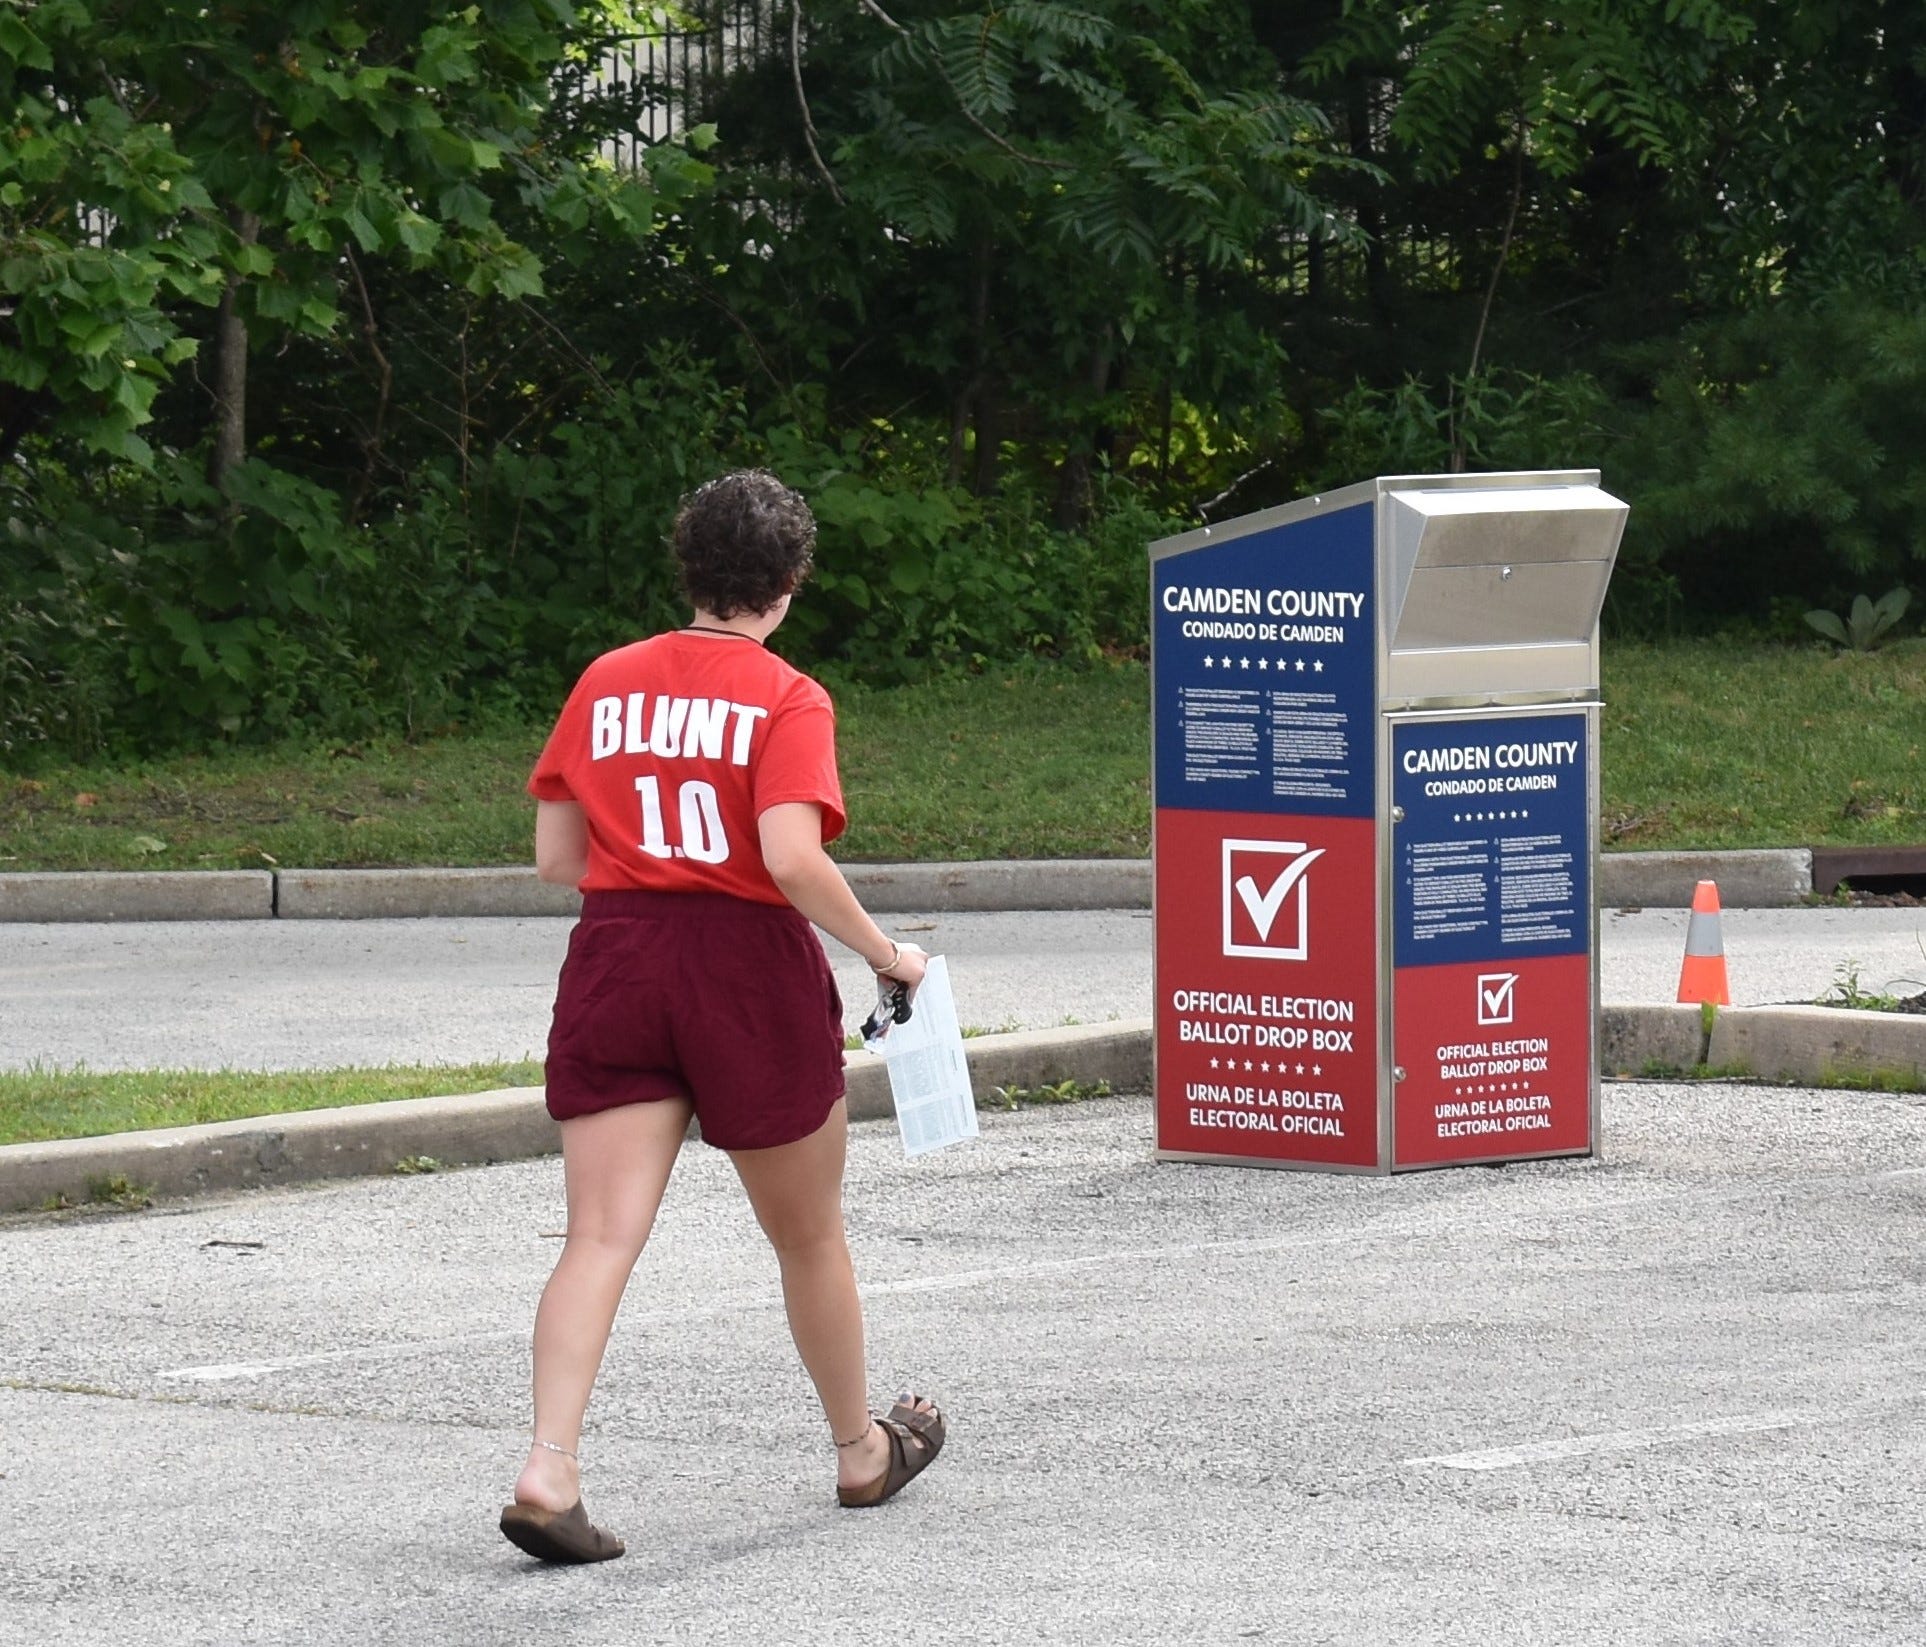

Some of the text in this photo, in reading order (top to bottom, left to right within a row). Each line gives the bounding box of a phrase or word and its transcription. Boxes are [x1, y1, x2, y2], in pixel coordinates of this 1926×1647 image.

[1163, 586, 1364, 617] CAMDEN COUNTY
[1183, 621, 1343, 642] CONDADO DE CAMDEN
[592, 693, 768, 766] BLUNT
[1404, 741, 1577, 773] CAMDEN COUNTY
[1425, 775, 1556, 796] CONDADO DE CAMDEN
[1174, 990, 1353, 1022] OFFICIAL ELECTION
[1180, 1021, 1353, 1052] BALLOT DROP BOX
[1437, 1038, 1548, 1060] OFFICIAL ELECTION
[1441, 1057, 1547, 1079] BALLOT DROP BOX
[1186, 1083, 1344, 1112] URNA DE LA BOLETA
[1435, 1096, 1551, 1118] URNA DE LA BOLETA
[1190, 1108, 1344, 1136] ELECTORAL OFICIAL
[1438, 1114, 1551, 1137] ELECTORAL OFICIAL
